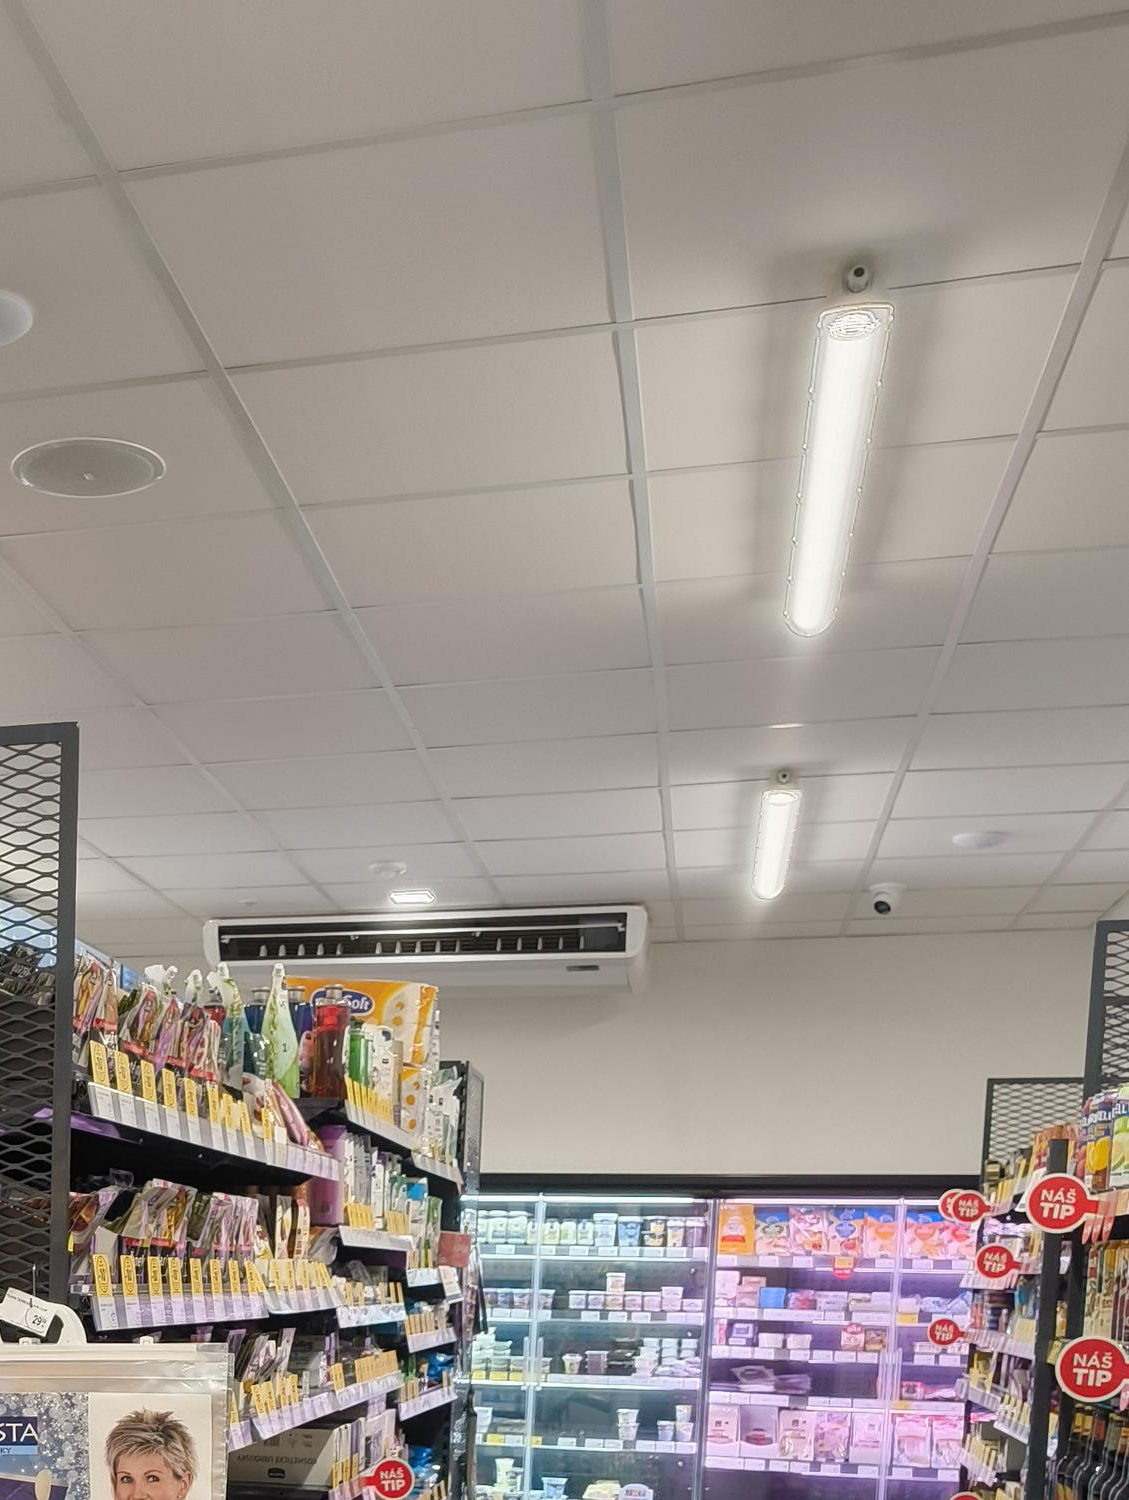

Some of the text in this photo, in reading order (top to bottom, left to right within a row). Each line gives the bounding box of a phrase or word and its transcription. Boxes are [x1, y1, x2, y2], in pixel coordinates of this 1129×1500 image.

[1041, 1189, 1077, 1204] NÁŠ
[958, 1207, 979, 1218] TIP
[1040, 1202, 1075, 1220] TIP
[984, 1252, 1008, 1264] NÁŠ
[983, 1261, 1005, 1272] TIP
[935, 1332, 952, 1342] TIP
[1073, 1353, 1113, 1369] NÁŠ
[1073, 1368, 1112, 1387] TIP
[380, 1468, 405, 1480] NÁŠ
[381, 1479, 405, 1492] TIP
